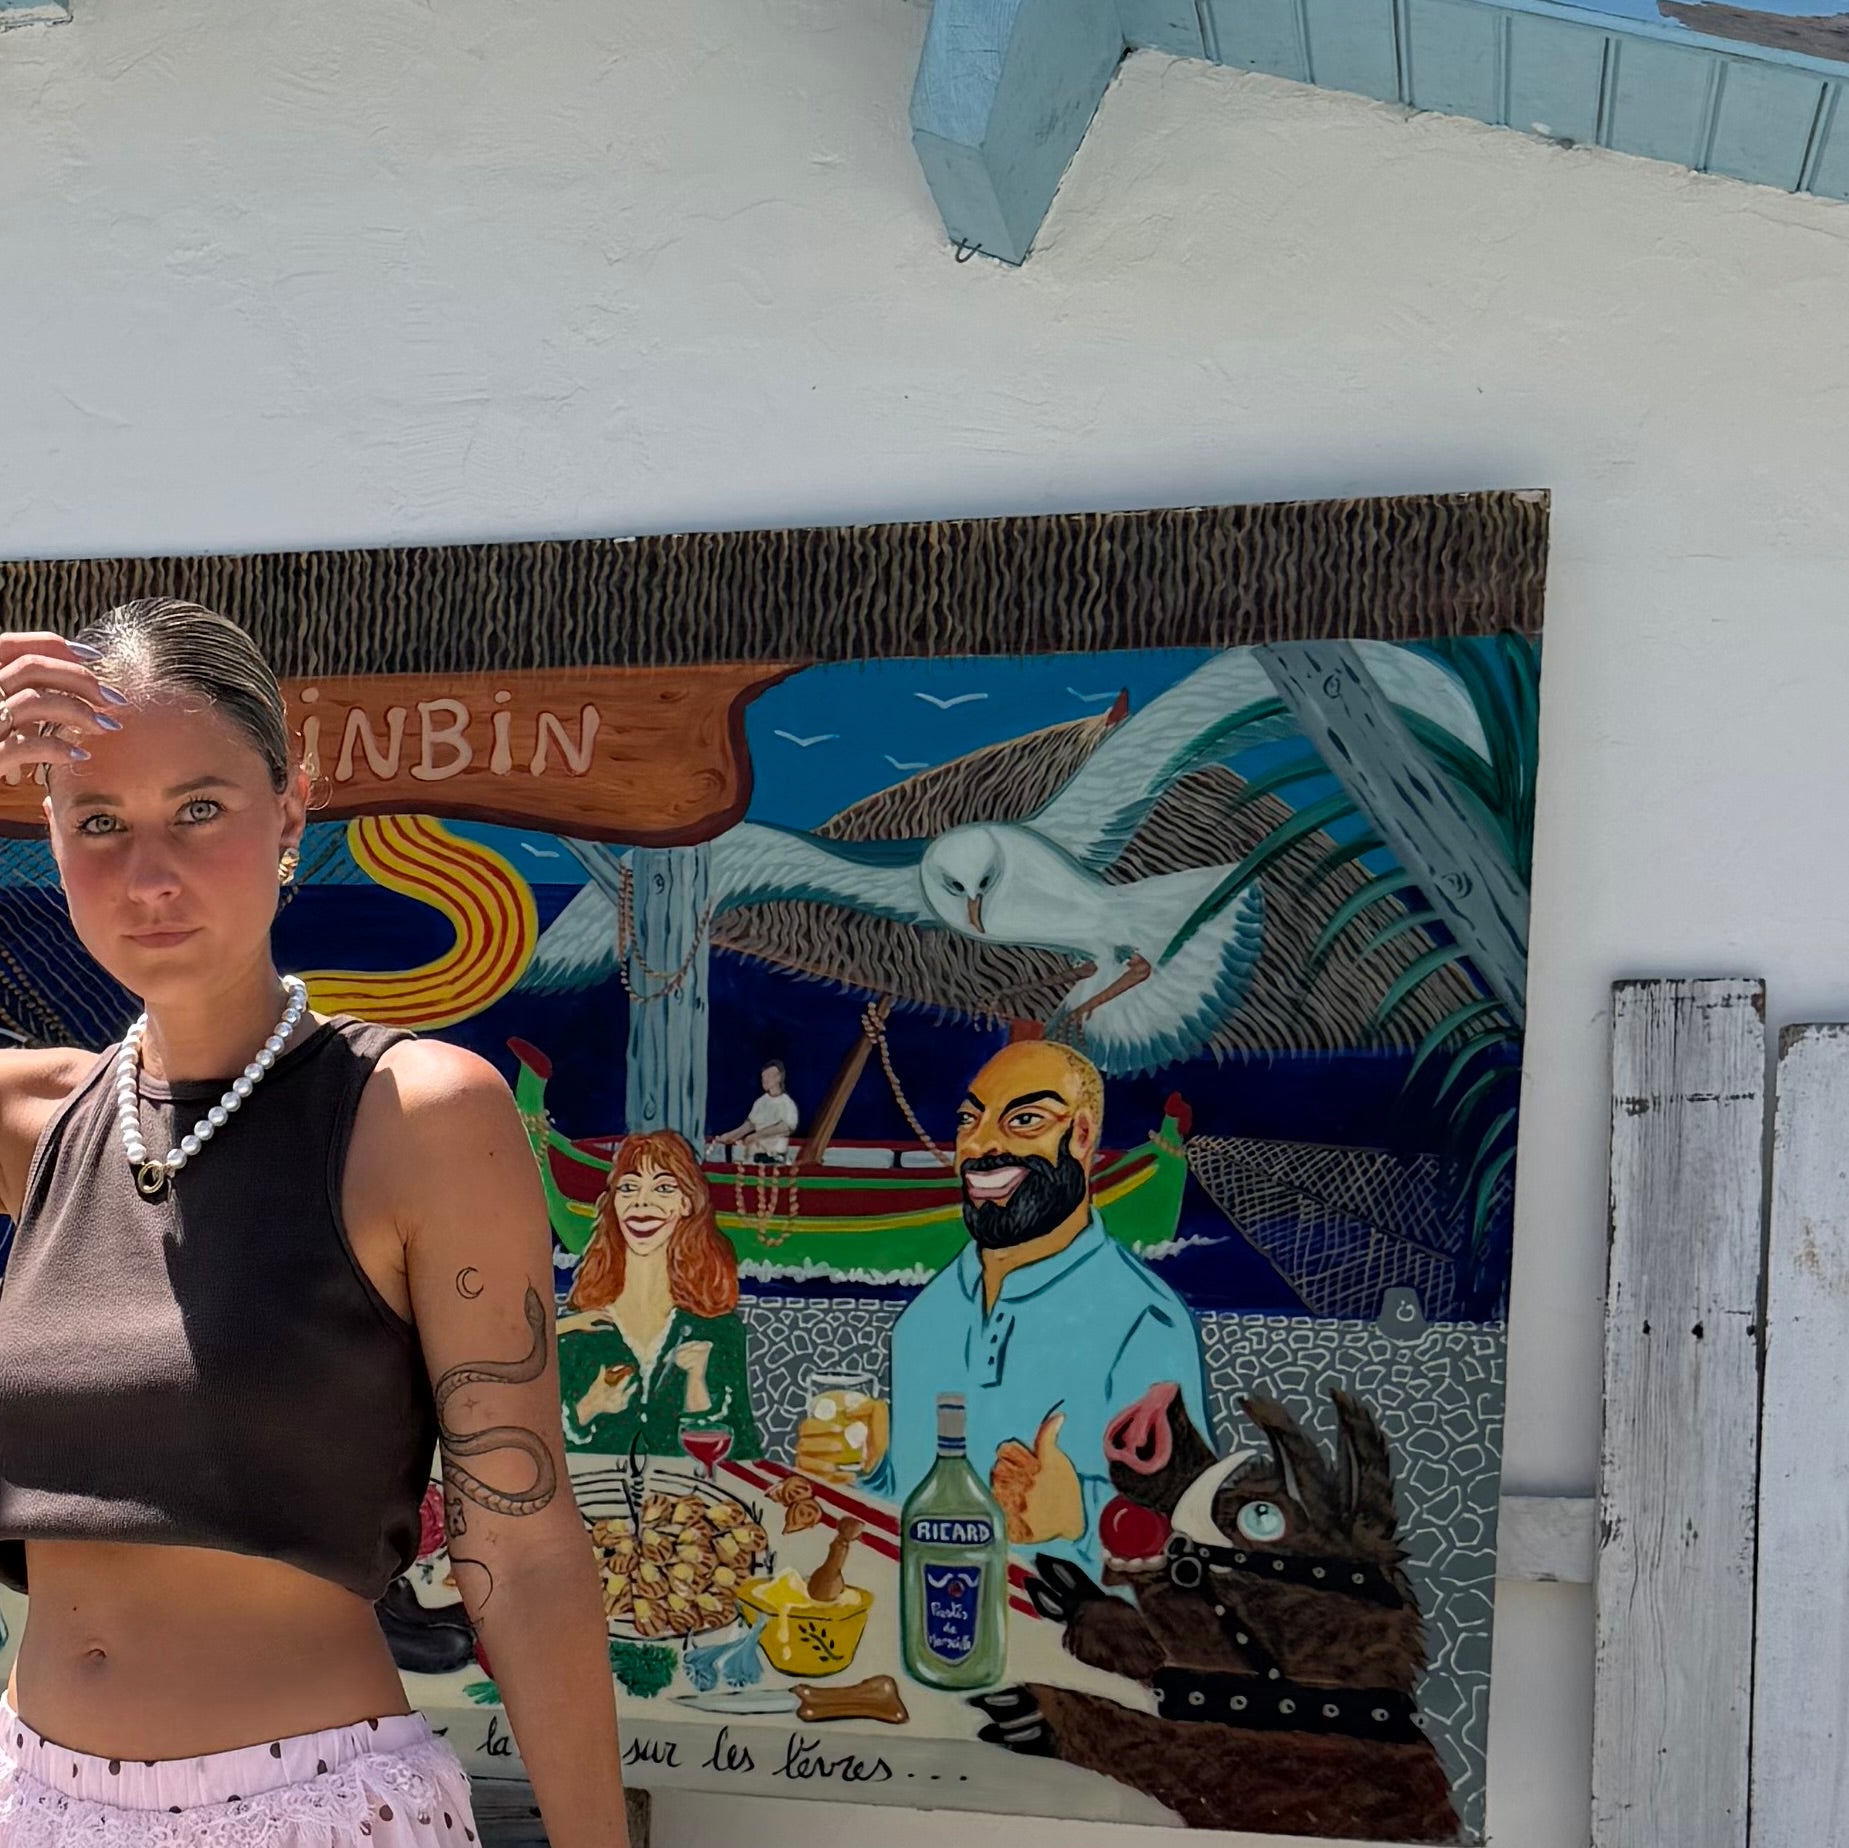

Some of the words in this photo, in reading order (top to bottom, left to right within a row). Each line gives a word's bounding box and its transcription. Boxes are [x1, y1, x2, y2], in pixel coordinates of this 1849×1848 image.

[916, 1521, 991, 1543] RICARD
[622, 1737, 681, 1768] sur
[701, 1725, 755, 1773] les
